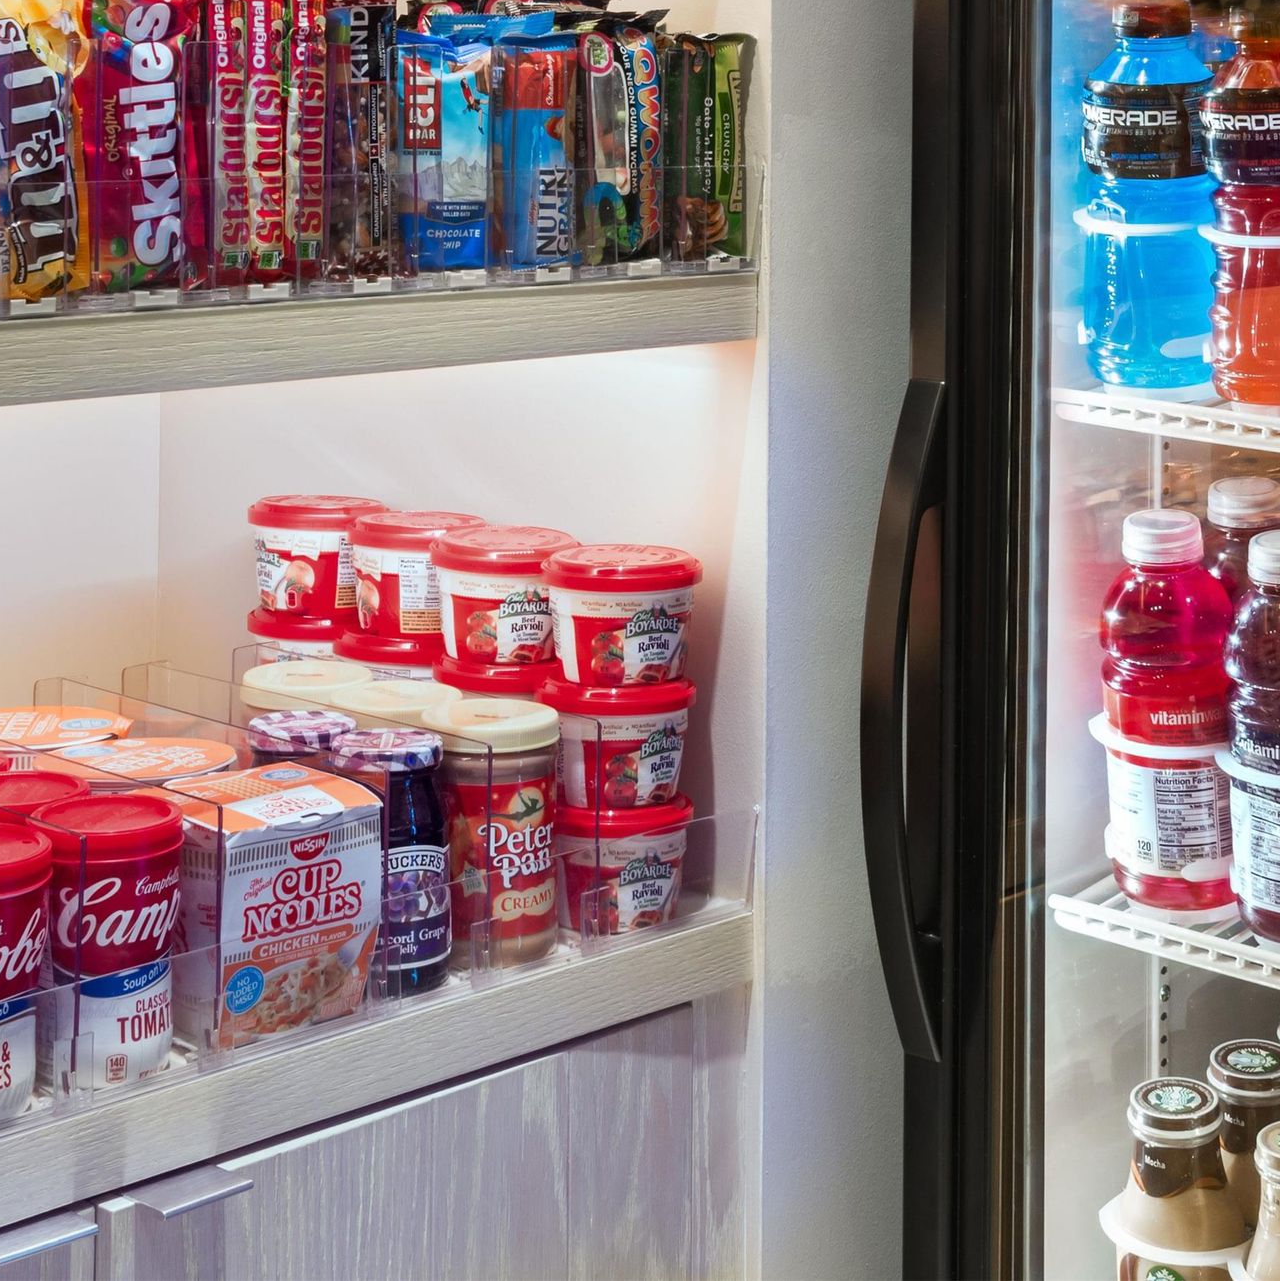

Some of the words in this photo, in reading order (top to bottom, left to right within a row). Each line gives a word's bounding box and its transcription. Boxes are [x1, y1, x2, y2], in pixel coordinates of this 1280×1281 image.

[252, 0, 265, 68] Original
[350, 8, 369, 83] KIND
[625, 72, 634, 108] NEON
[119, 1, 185, 267] Skittles
[628, 109, 637, 148] GUMMI
[219, 72, 249, 246] Starburst
[252, 72, 283, 247] Starburst
[293, 68, 325, 235] Starburst
[631, 150, 639, 195] WORMS
[536, 168, 557, 256] NUTRI
[426, 228, 481, 239] CHOCOLATE
[510, 620, 544, 633] Ravioli
[625, 617, 679, 638] BOYARDEE
[637, 640, 670, 654] Ravioli
[293, 836, 326, 854] NISSIN
[477, 821, 554, 857] Peter
[275, 860, 341, 900] CUP
[493, 847, 552, 889] Pan
[620, 864, 673, 884] BOYARDEE
[501, 889, 553, 912] CREAMY
[631, 885, 664, 900] Ravioli
[57, 877, 182, 951] Camp
[243, 884, 362, 941] NOODLES
[258, 933, 320, 959] CHICKEN
[320, 930, 347, 943] FLAVOR
[0, 1041, 11, 1062] &
[1144, 1154, 1167, 1171] Mocha
